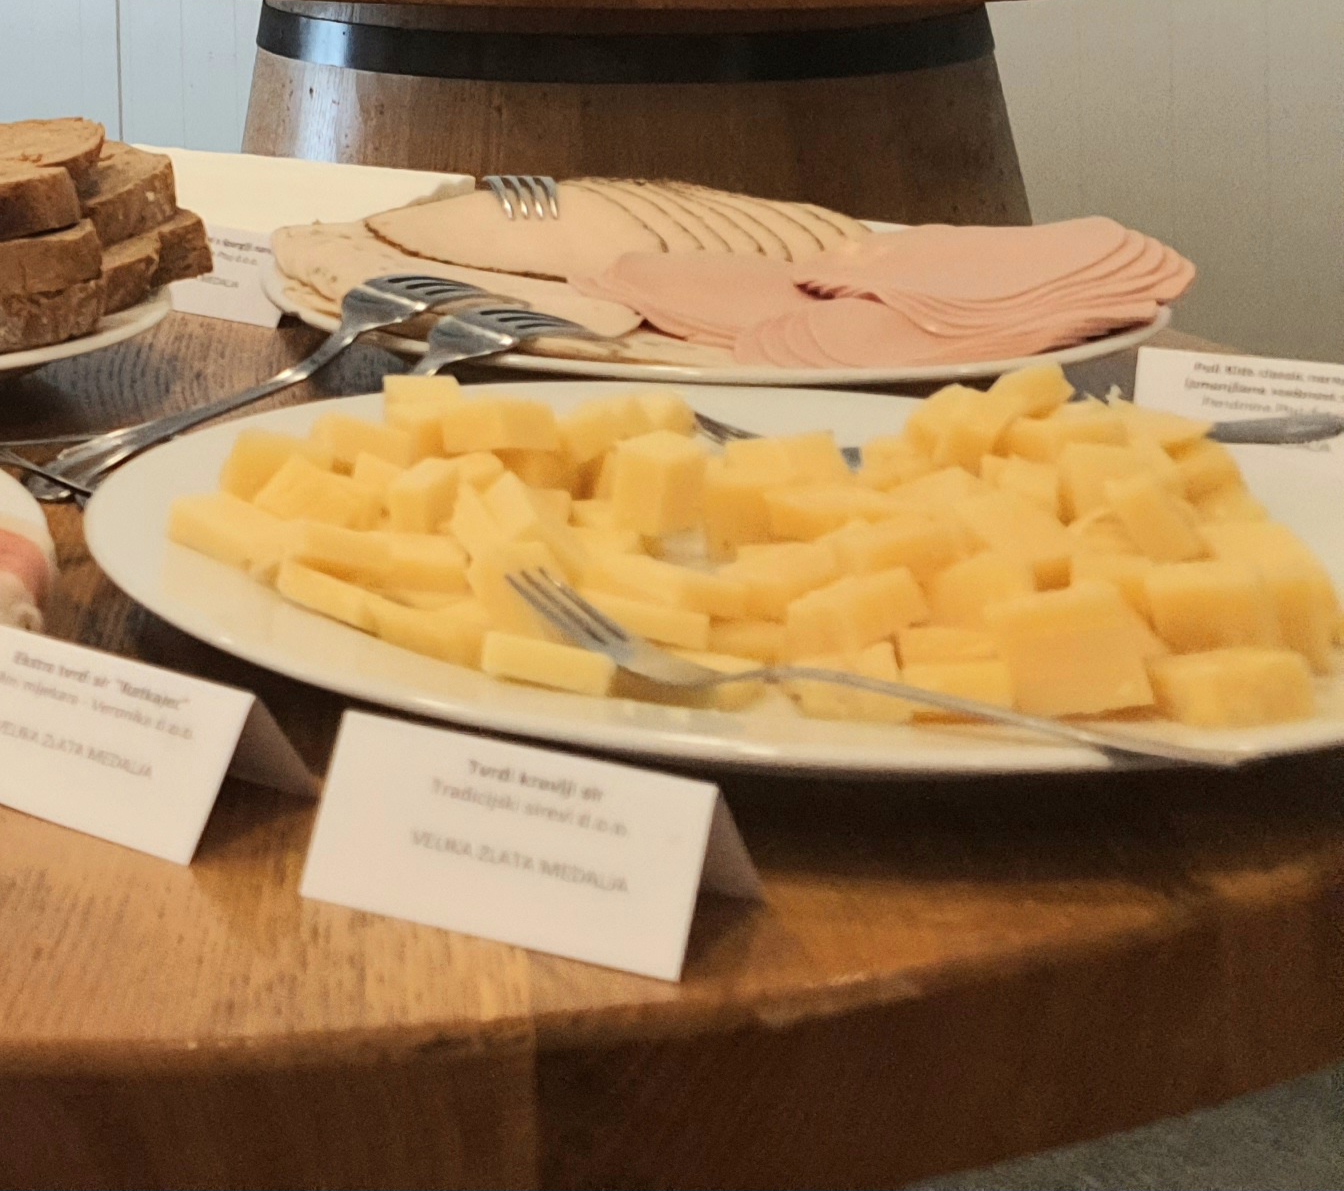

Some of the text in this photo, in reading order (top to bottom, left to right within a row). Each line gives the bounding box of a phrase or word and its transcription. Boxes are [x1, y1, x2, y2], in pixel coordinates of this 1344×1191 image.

[41, 732, 84, 756] ZLATA
[467, 758, 604, 803] Tvrdi kravlji sir
[412, 829, 629, 893] VELIKA ZLATA MEDALJA
